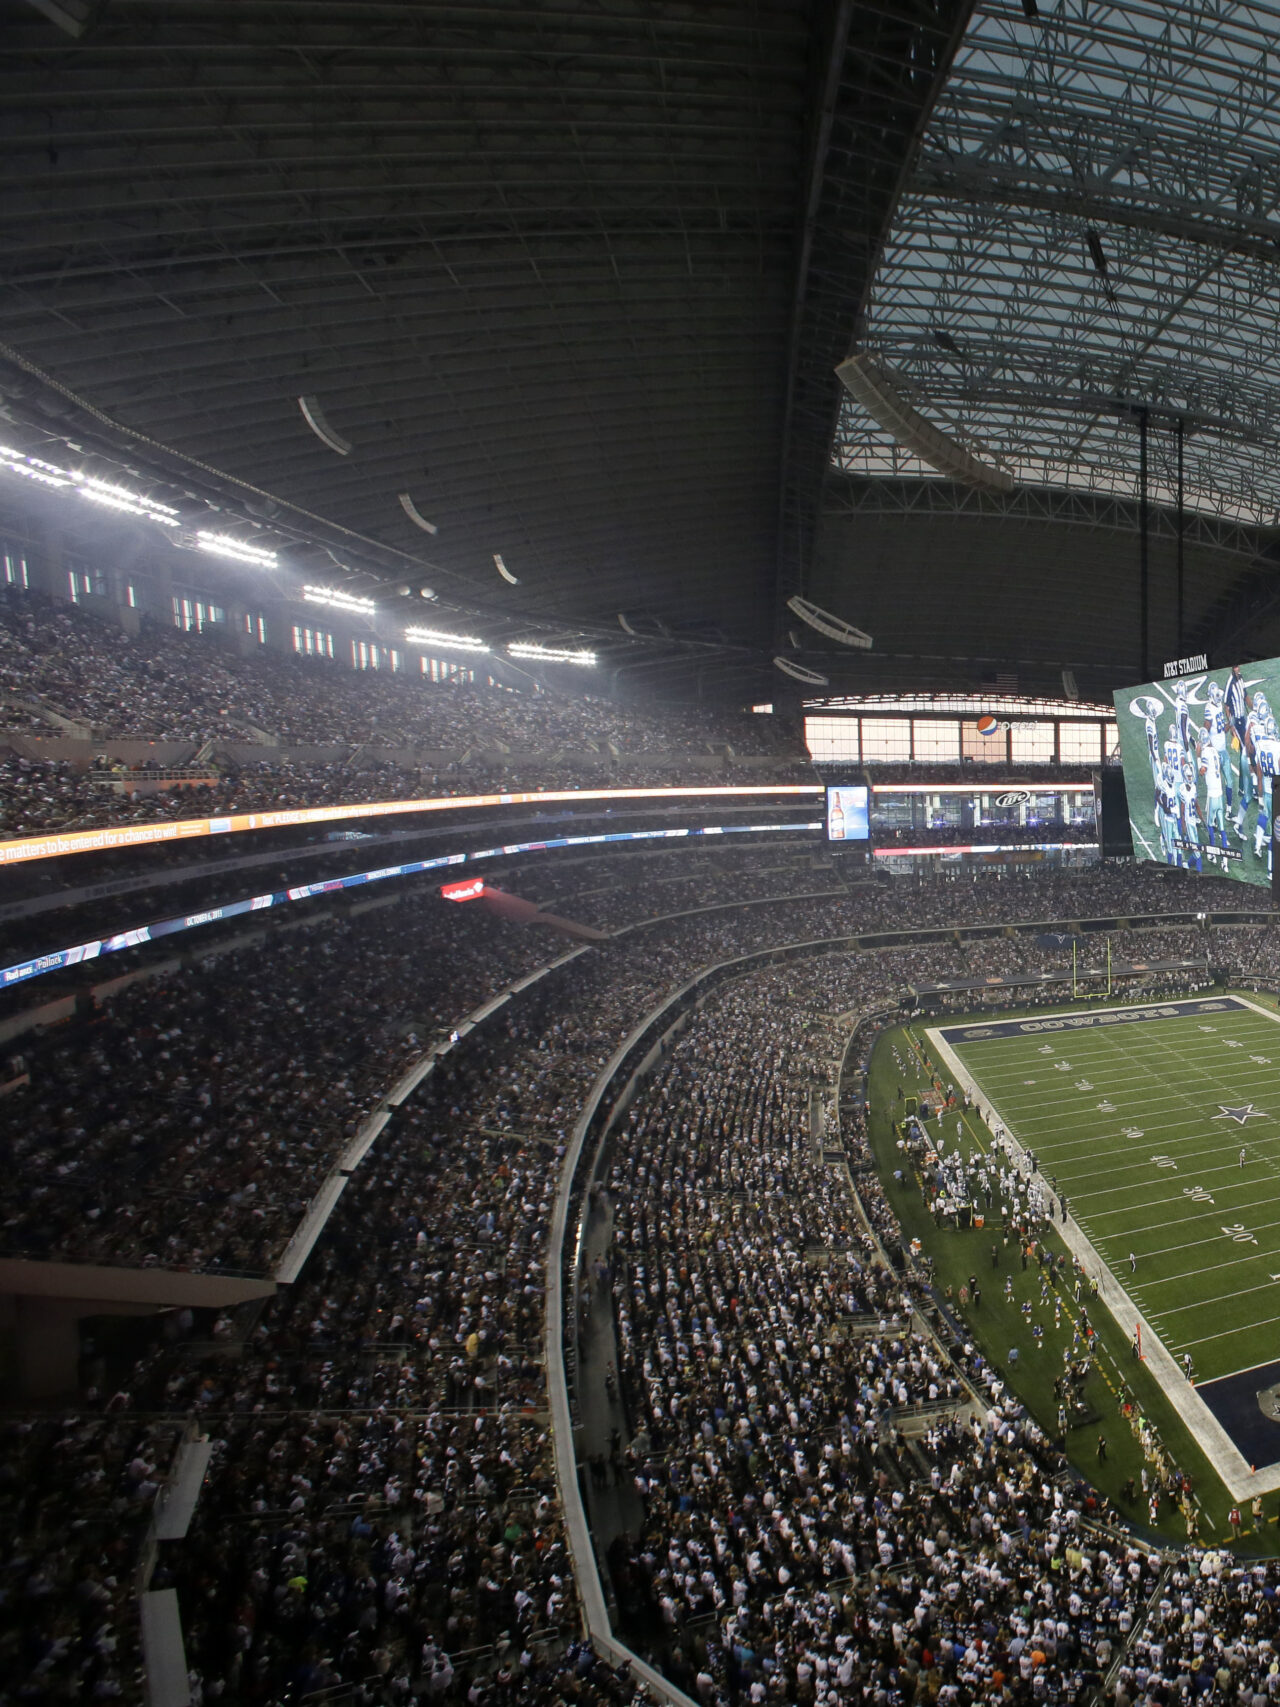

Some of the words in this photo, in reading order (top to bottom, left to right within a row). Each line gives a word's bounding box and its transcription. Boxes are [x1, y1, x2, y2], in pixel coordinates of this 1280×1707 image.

[1163, 661, 1178, 678] AT&T
[1178, 653, 1208, 675] STADIUM
[1259, 751, 1273, 776] 68
[6, 842, 46, 859] matters
[46, 841, 57, 854] to
[57, 838, 70, 852] be
[70, 834, 104, 850] entered
[105, 831, 118, 844] for
[118, 834, 125, 844] a
[125, 828, 153, 842] chance
[154, 827, 162, 838] to
[163, 825, 177, 837] win!
[185, 912, 208, 926] OCTOBER
[5, 964, 33, 981] Radance
[37, 953, 62, 970] Pollock
[1183, 1185, 1211, 1201] 30
[1221, 1223, 1254, 1242] 20
